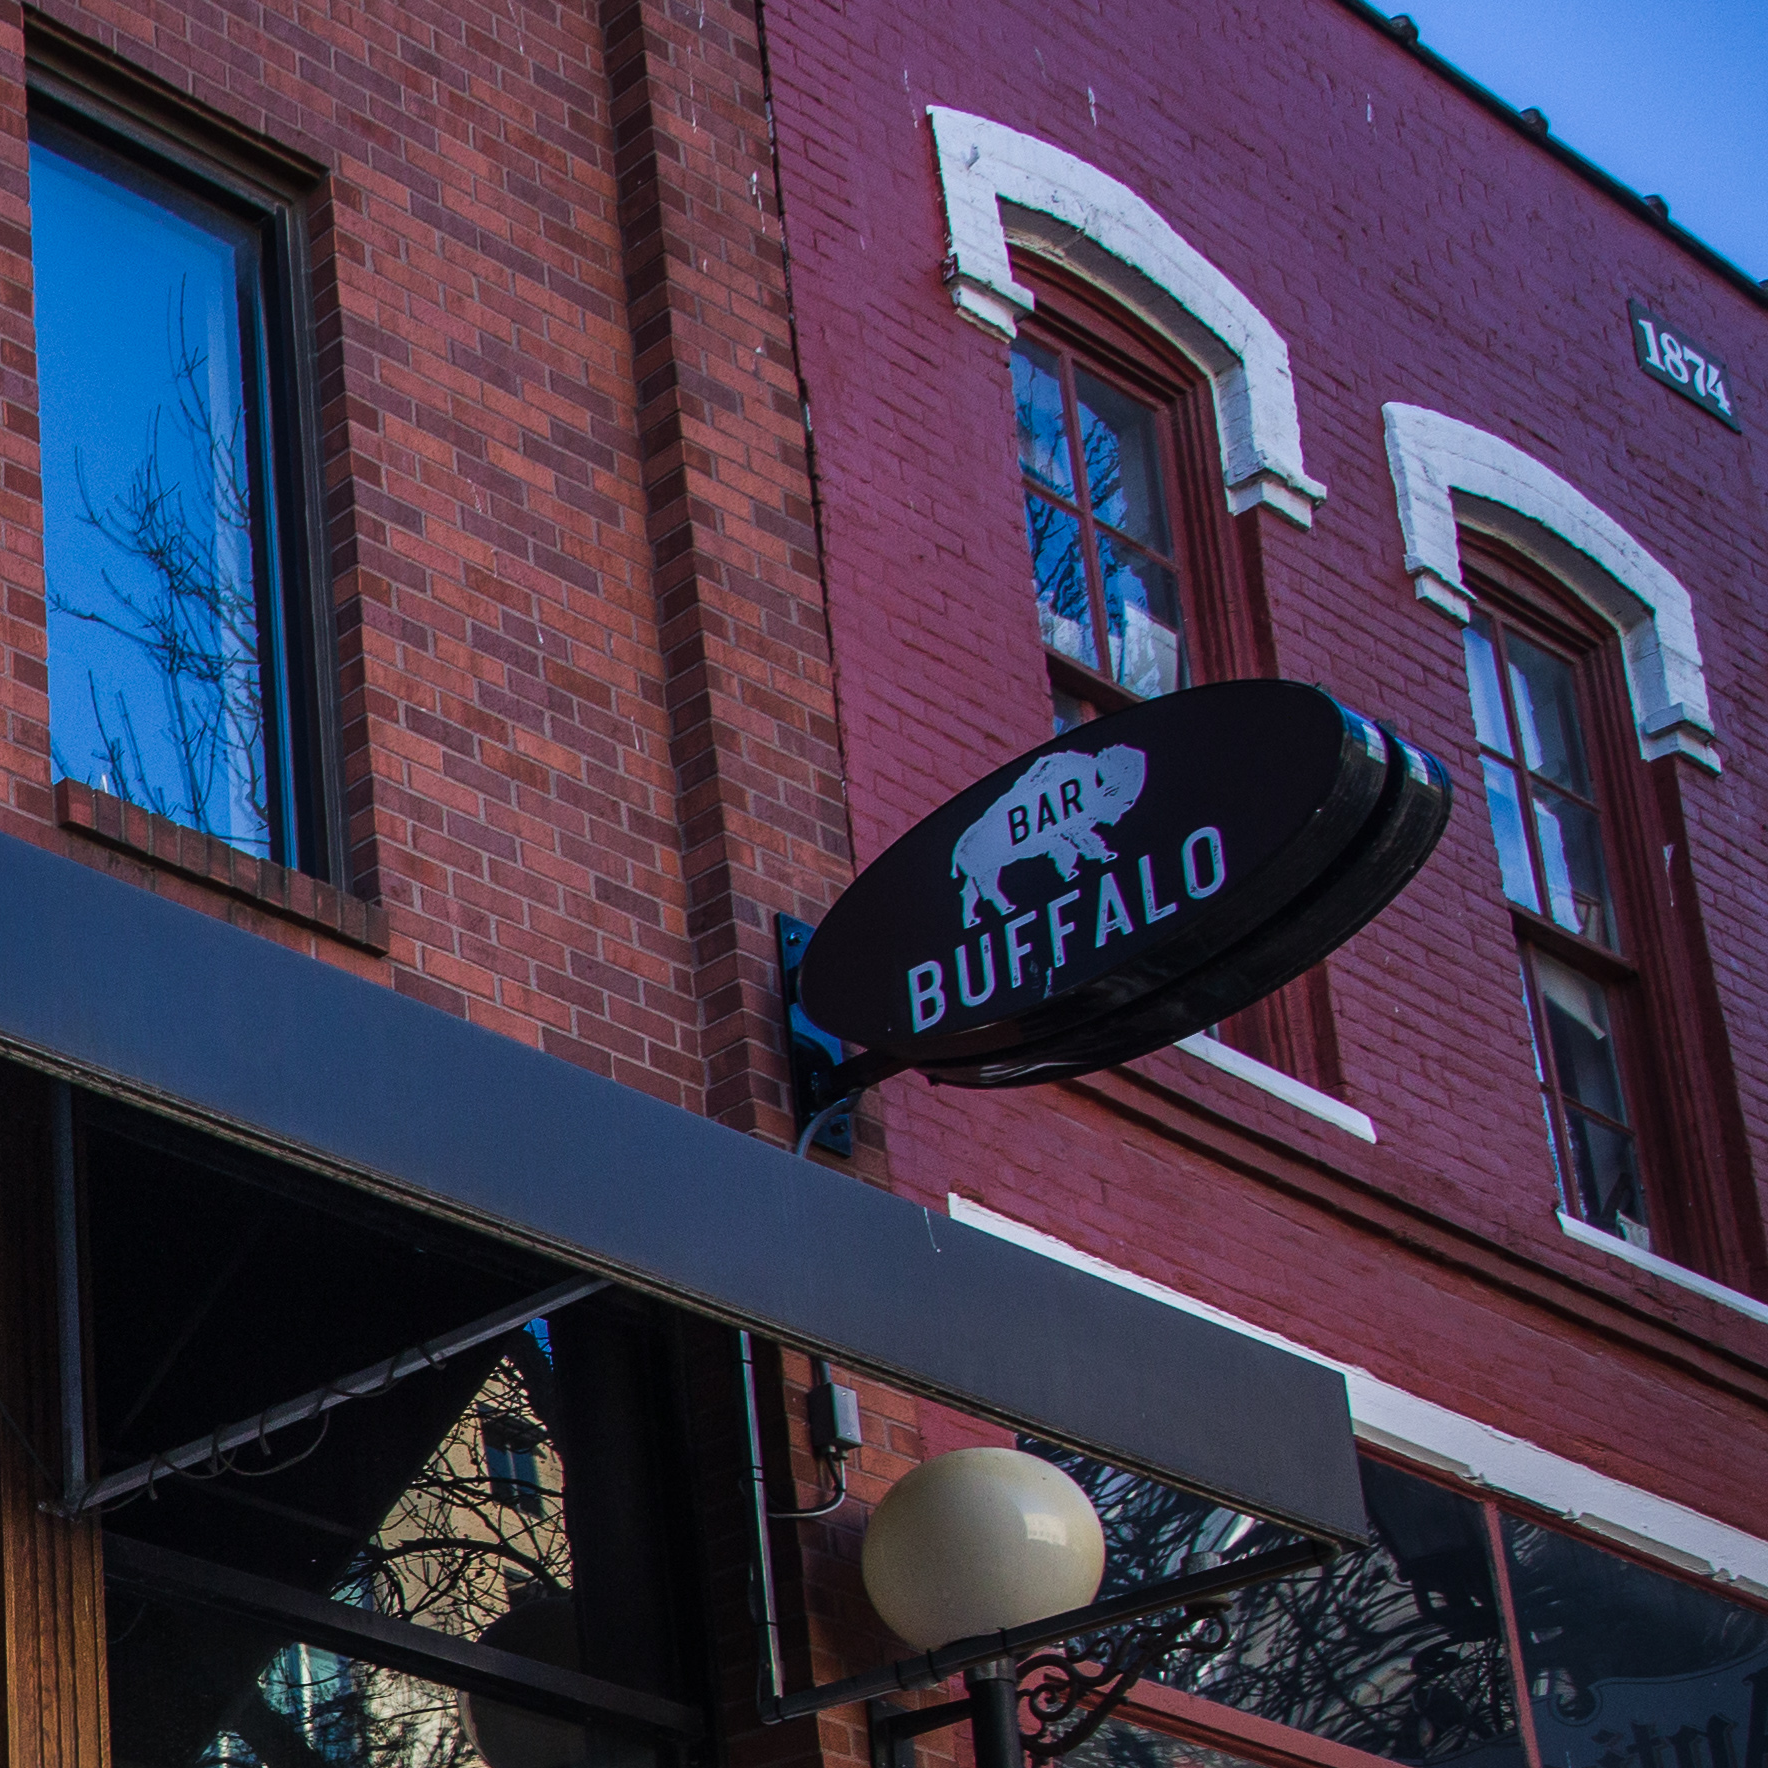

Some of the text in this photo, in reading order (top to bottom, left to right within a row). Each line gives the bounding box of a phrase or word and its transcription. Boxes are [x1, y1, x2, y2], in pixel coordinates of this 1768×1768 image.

[1637, 319, 1732, 416] 1874
[1006, 777, 1085, 847] BAR
[907, 826, 1227, 1033] BUFFALO
